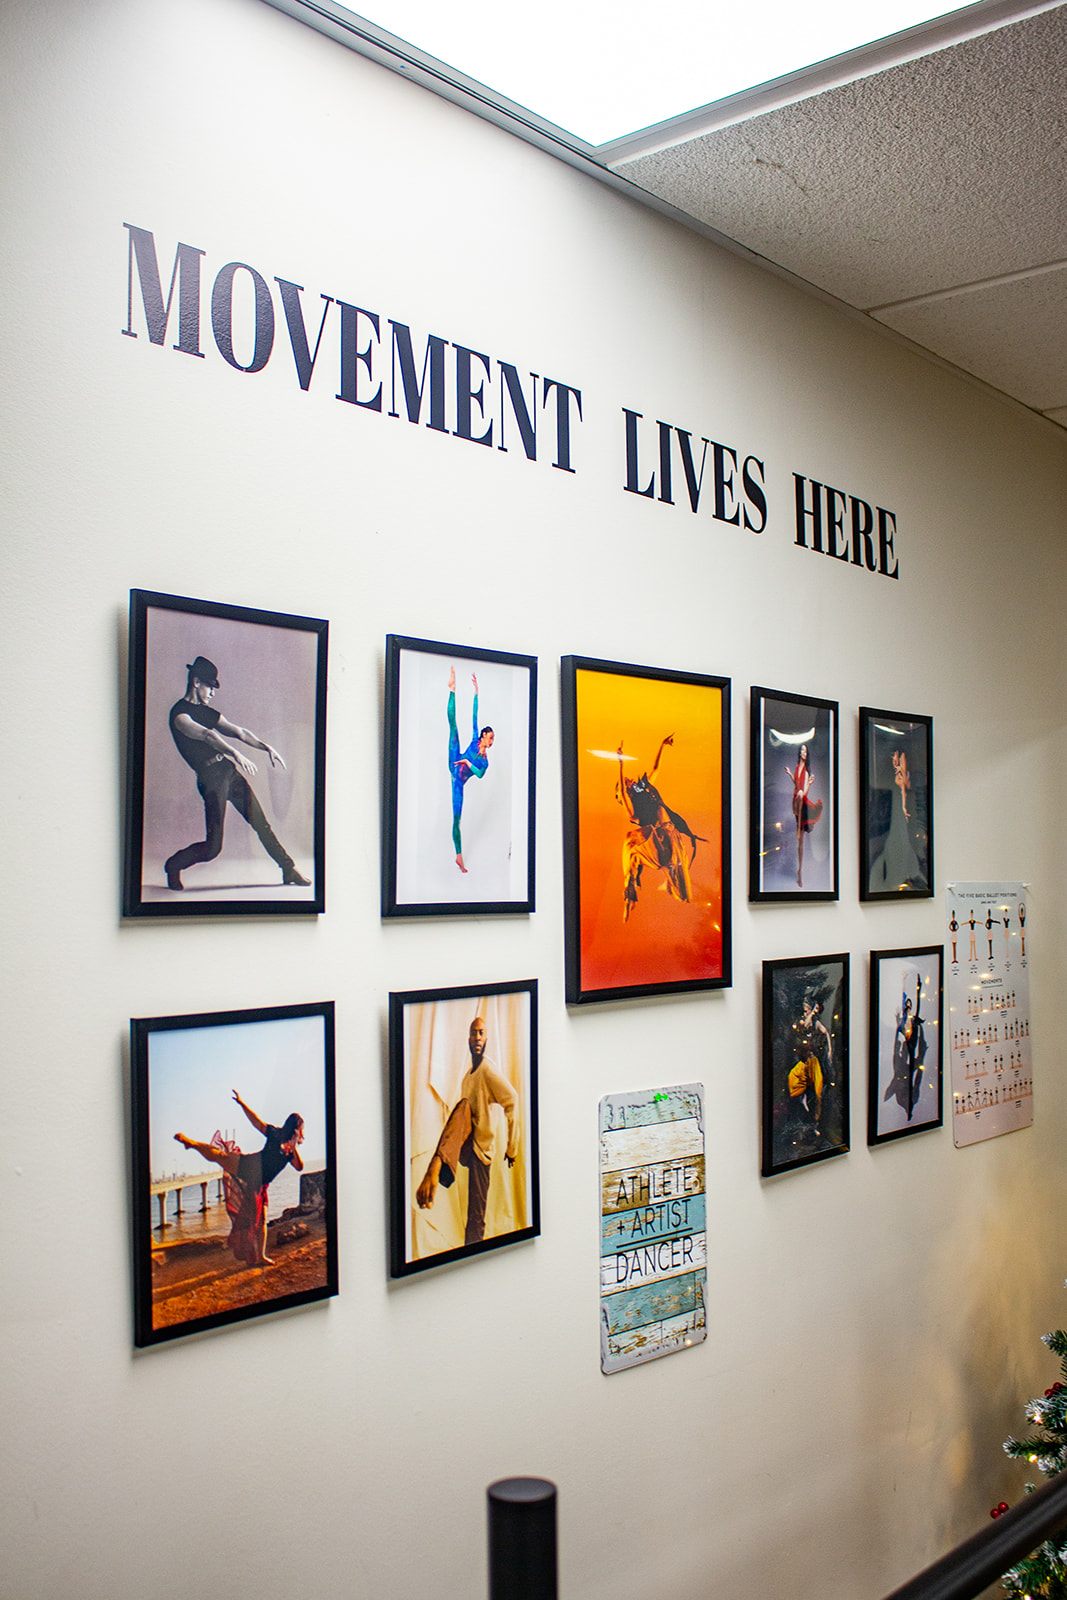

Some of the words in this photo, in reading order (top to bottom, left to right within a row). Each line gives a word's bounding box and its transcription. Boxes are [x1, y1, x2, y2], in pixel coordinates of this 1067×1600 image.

[122, 222, 583, 474] MOVEMENT
[621, 407, 767, 535] LIVES
[792, 472, 900, 580] HERE
[616, 1165, 694, 1206] ATHLETE
[631, 1199, 691, 1238] ARTIST
[615, 1236, 694, 1283] DANCER
